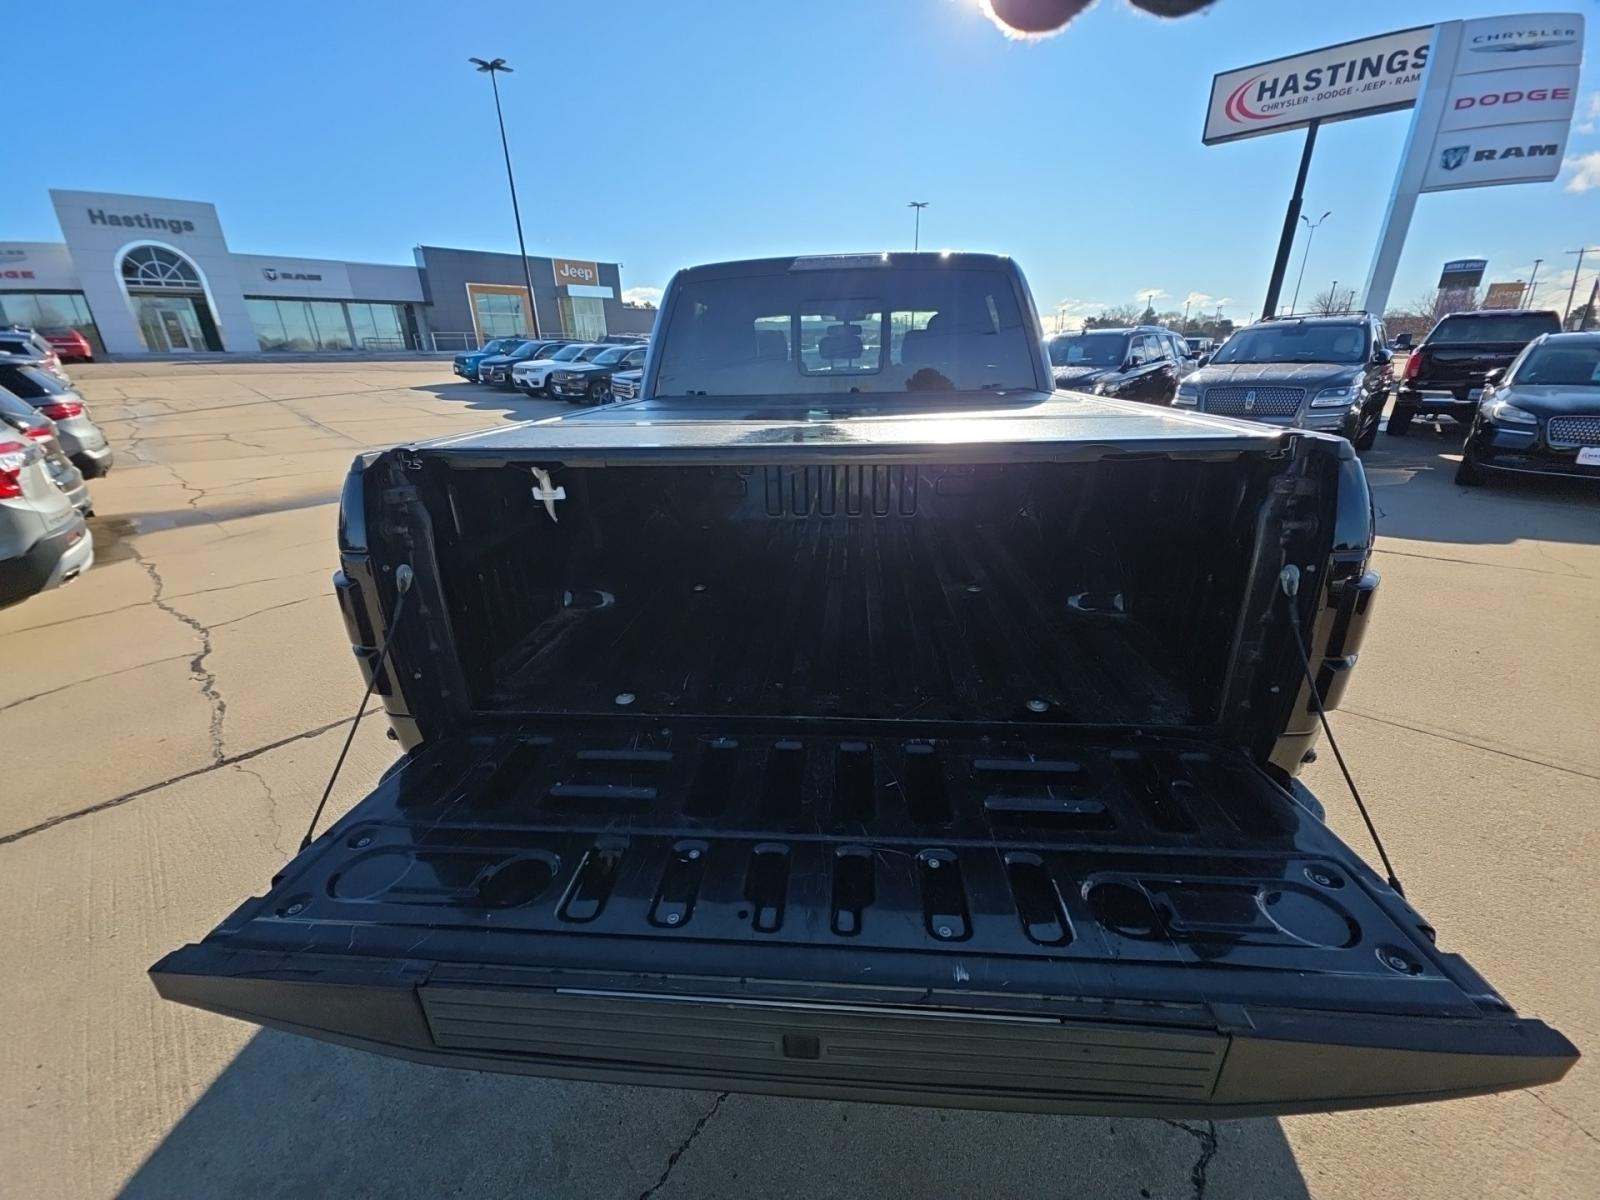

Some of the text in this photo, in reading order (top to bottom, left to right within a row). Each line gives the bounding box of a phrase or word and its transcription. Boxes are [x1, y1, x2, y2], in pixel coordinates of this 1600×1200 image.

[1472, 29, 1576, 44] CHRYSLER
[1256, 45, 1430, 102] HASTINGS
[1260, 74, 1421, 113] CHRYSLER DODGE JEEP RAM
[1454, 88, 1571, 110] DODGE
[1473, 144, 1559, 162] RAM
[87, 208, 195, 234] Hastings
[560, 263, 593, 281] Jeep
